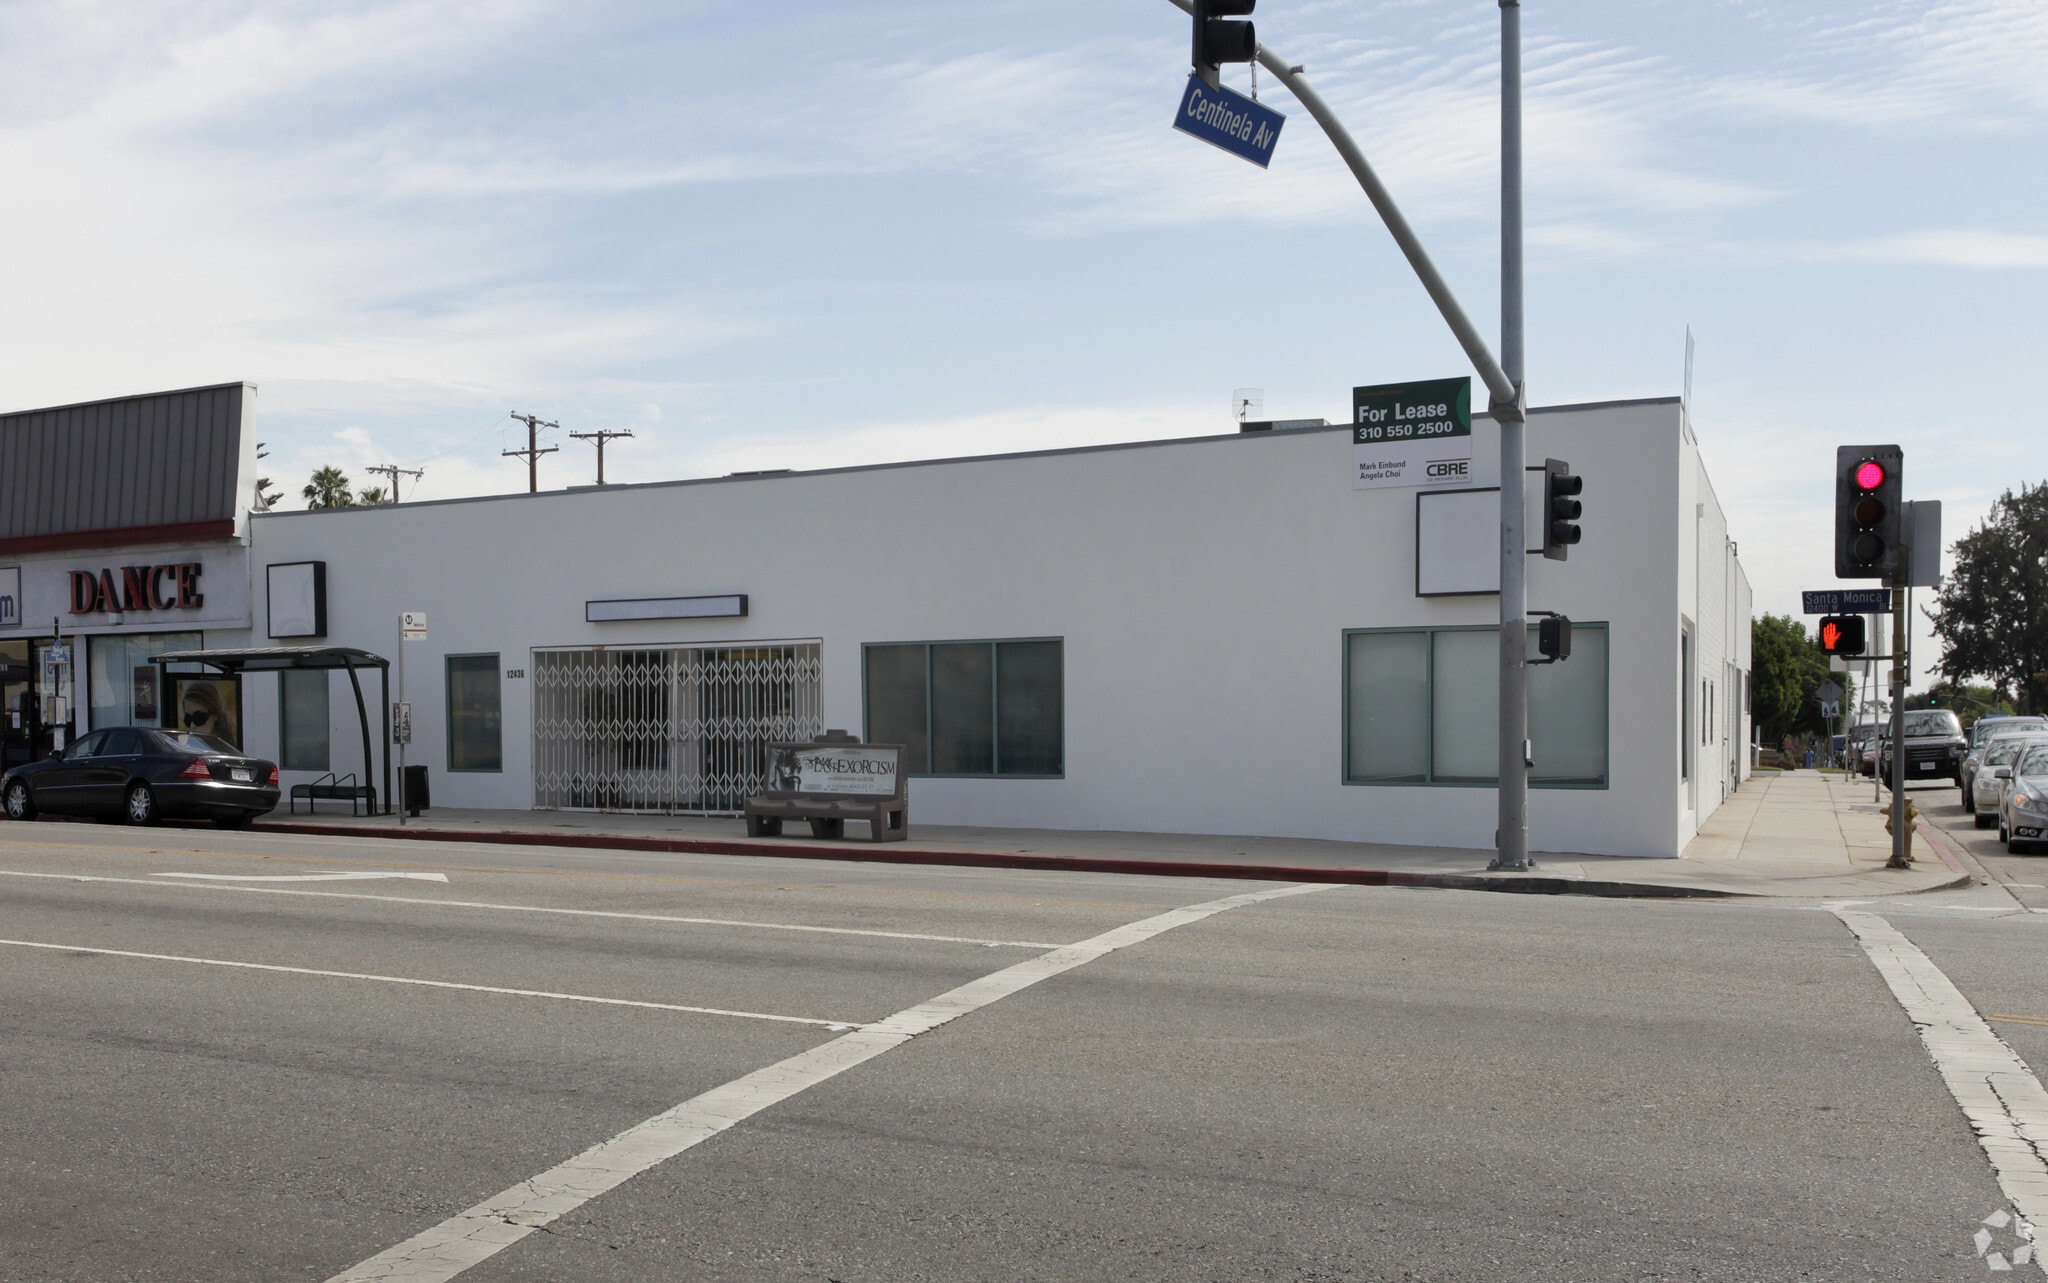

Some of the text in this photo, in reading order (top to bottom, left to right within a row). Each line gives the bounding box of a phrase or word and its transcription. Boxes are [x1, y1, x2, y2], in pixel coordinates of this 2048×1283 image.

[1187, 88, 1274, 150] Centinela Av
[1358, 402, 1447, 423] For Lease
[1359, 421, 1453, 439] 310 550 2500
[1378, 460, 1406, 469] Einbund
[1426, 462, 1468, 477] CBRE
[1360, 470, 1401, 480] Angela Choi
[67, 562, 204, 614] DANCE
[1806, 591, 1883, 604] Santa Monica
[1806, 604, 1829, 612] 12400
[837, 759, 895, 775] EXORCISM
